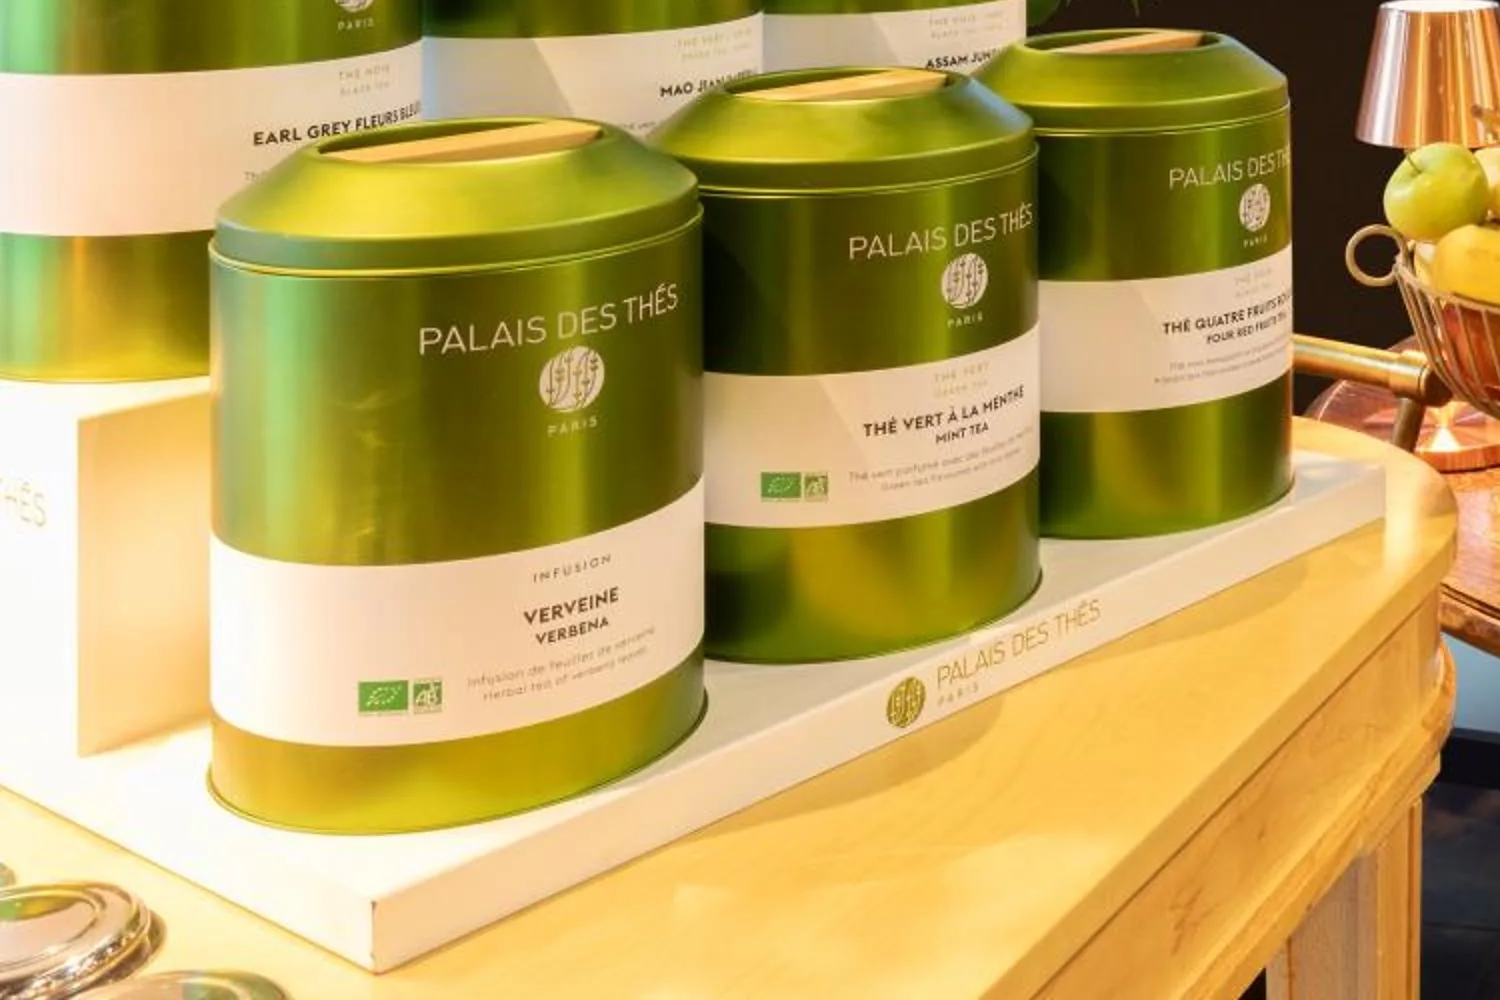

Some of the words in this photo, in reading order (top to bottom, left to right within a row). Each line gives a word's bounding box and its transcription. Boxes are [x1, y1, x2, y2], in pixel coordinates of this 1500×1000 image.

[337, 17, 375, 32] PARIS
[926, 54, 969, 70] ASSAM
[659, 81, 693, 97] MAO
[252, 127, 302, 146] EARL
[307, 119, 352, 140] GREY
[355, 110, 399, 131] FLEURS
[1169, 160, 1244, 190] PALAIS
[1247, 152, 1275, 177] DES
[849, 226, 947, 260] PALAIS
[954, 217, 997, 247] DES
[1000, 201, 1033, 235] THÉS
[418, 315, 548, 356] PALAIS
[557, 302, 617, 340] DES
[622, 283, 679, 325] THÉS
[947, 311, 984, 329] PARIS
[1194, 309, 1246, 331] QUATRE
[1247, 298, 1278, 319] FRUITS
[1206, 330, 1235, 344] FOUR
[1237, 324, 1255, 338] RED
[863, 416, 897, 437] THÉ
[903, 411, 944, 431] VERT
[947, 407, 959, 422] À
[962, 405, 979, 419] LA
[982, 384, 1025, 413] MENTHE
[547, 415, 598, 437] PARIS
[935, 427, 967, 445] MINT
[969, 421, 989, 436] TEA
[532, 554, 612, 583] INFUSION
[523, 586, 620, 625] VERVEINE
[535, 616, 609, 645] VERBENA
[937, 641, 1006, 690] PALAIS
[1012, 622, 1050, 657] DES
[1055, 599, 1101, 636] THÉS
[466, 667, 525, 688] Infusion
[527, 663, 546, 678] de
[530, 680, 552, 692] tea
[555, 673, 569, 687] of
[936, 682, 980, 708] PARIS
